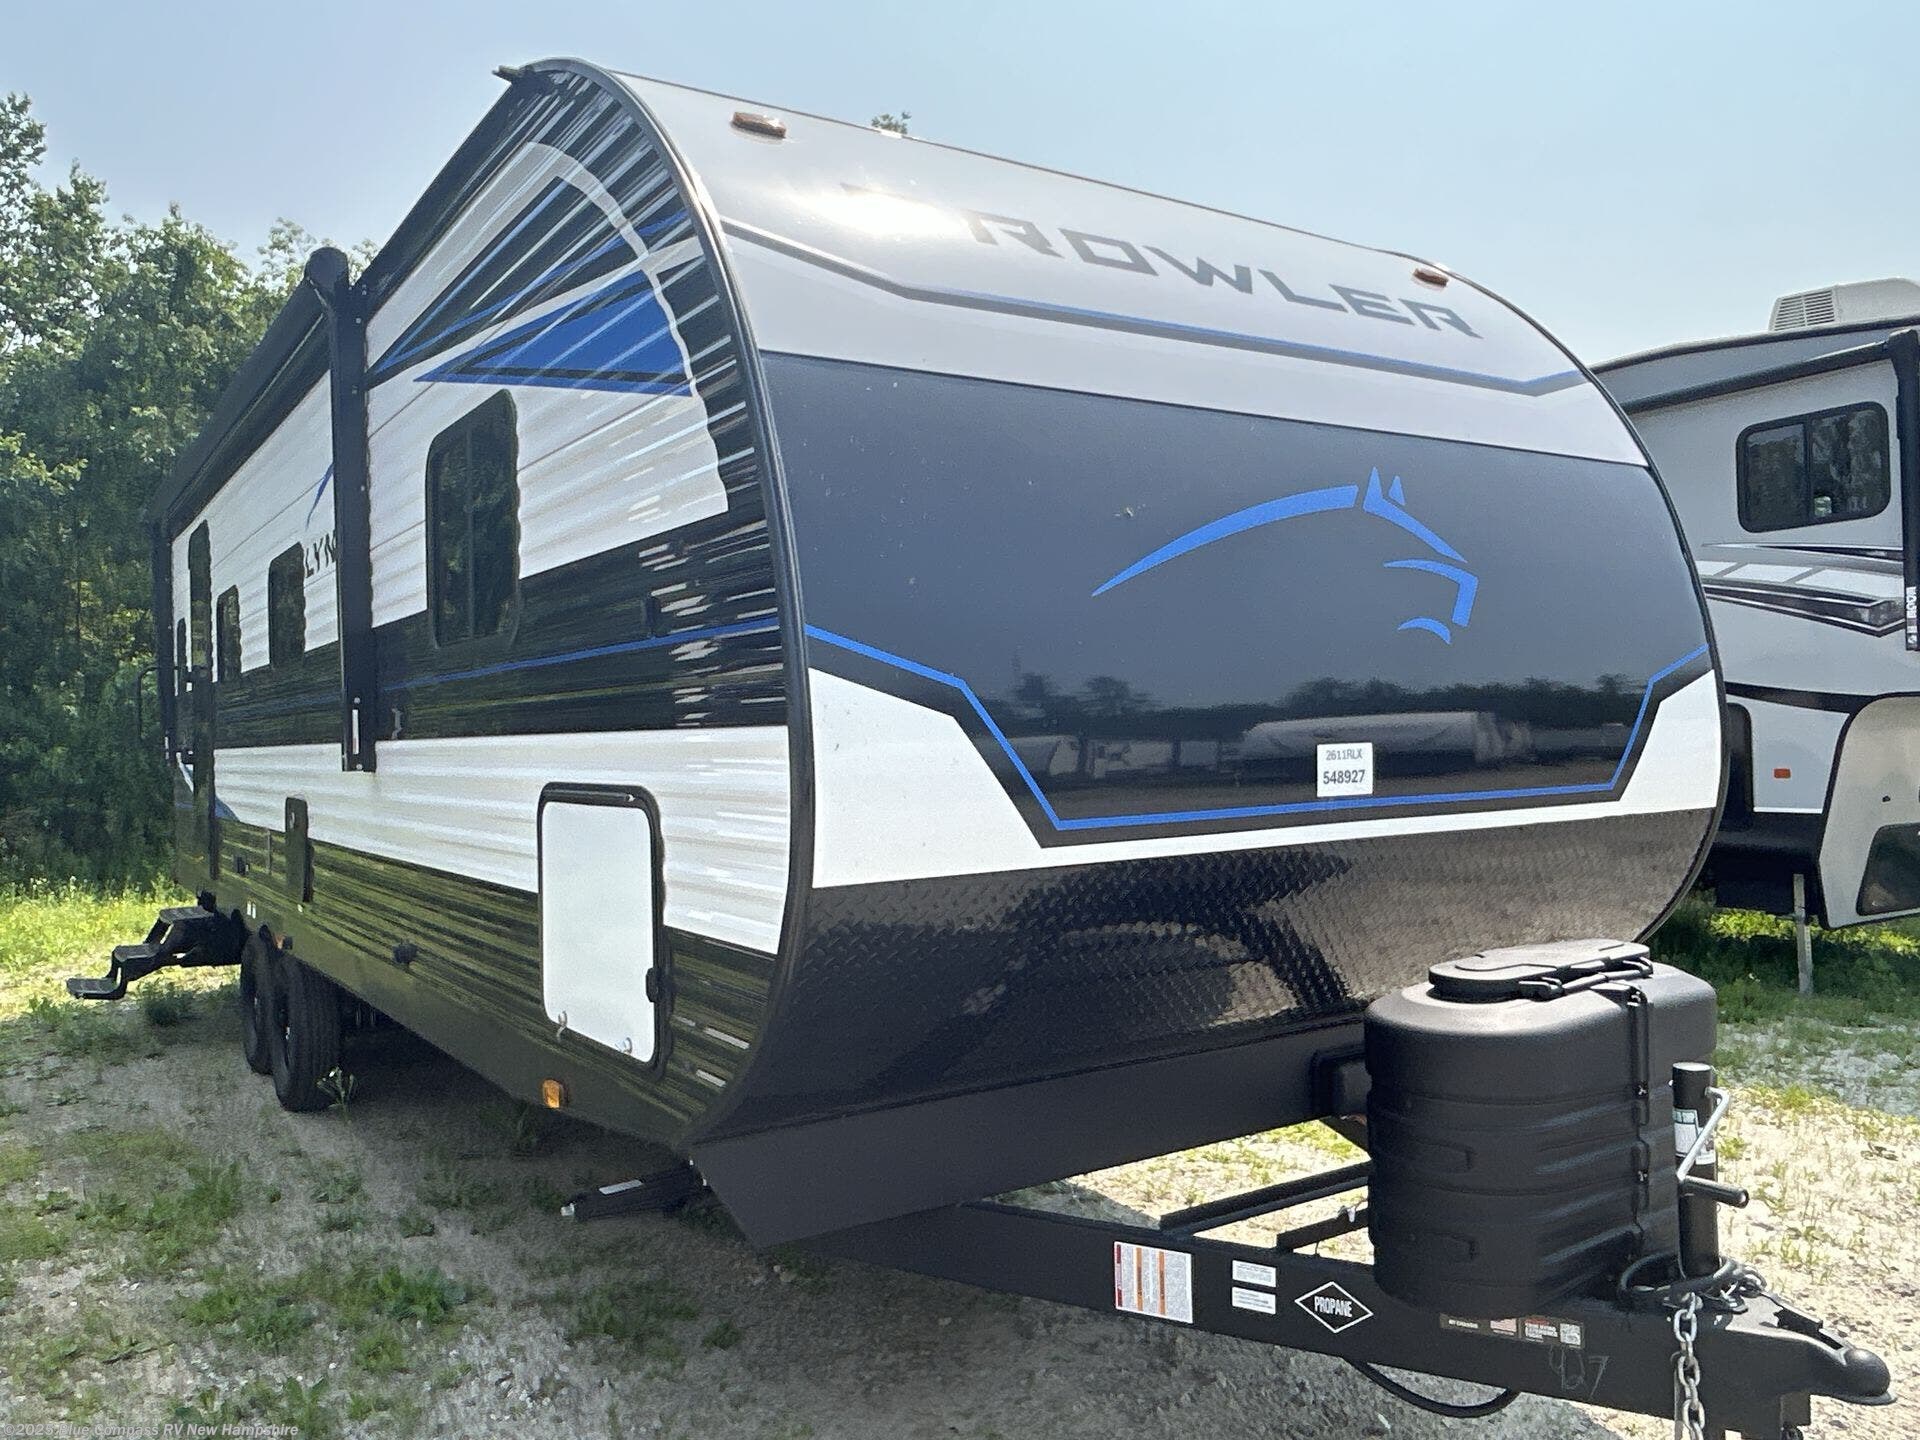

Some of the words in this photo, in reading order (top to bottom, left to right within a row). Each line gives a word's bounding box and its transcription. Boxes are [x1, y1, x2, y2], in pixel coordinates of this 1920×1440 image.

[840, 183, 1483, 339] ROWLER
[304, 531, 337, 579] LYN
[1323, 769, 1365, 785] 548927
[1314, 1296, 1353, 1317] PROPANE
